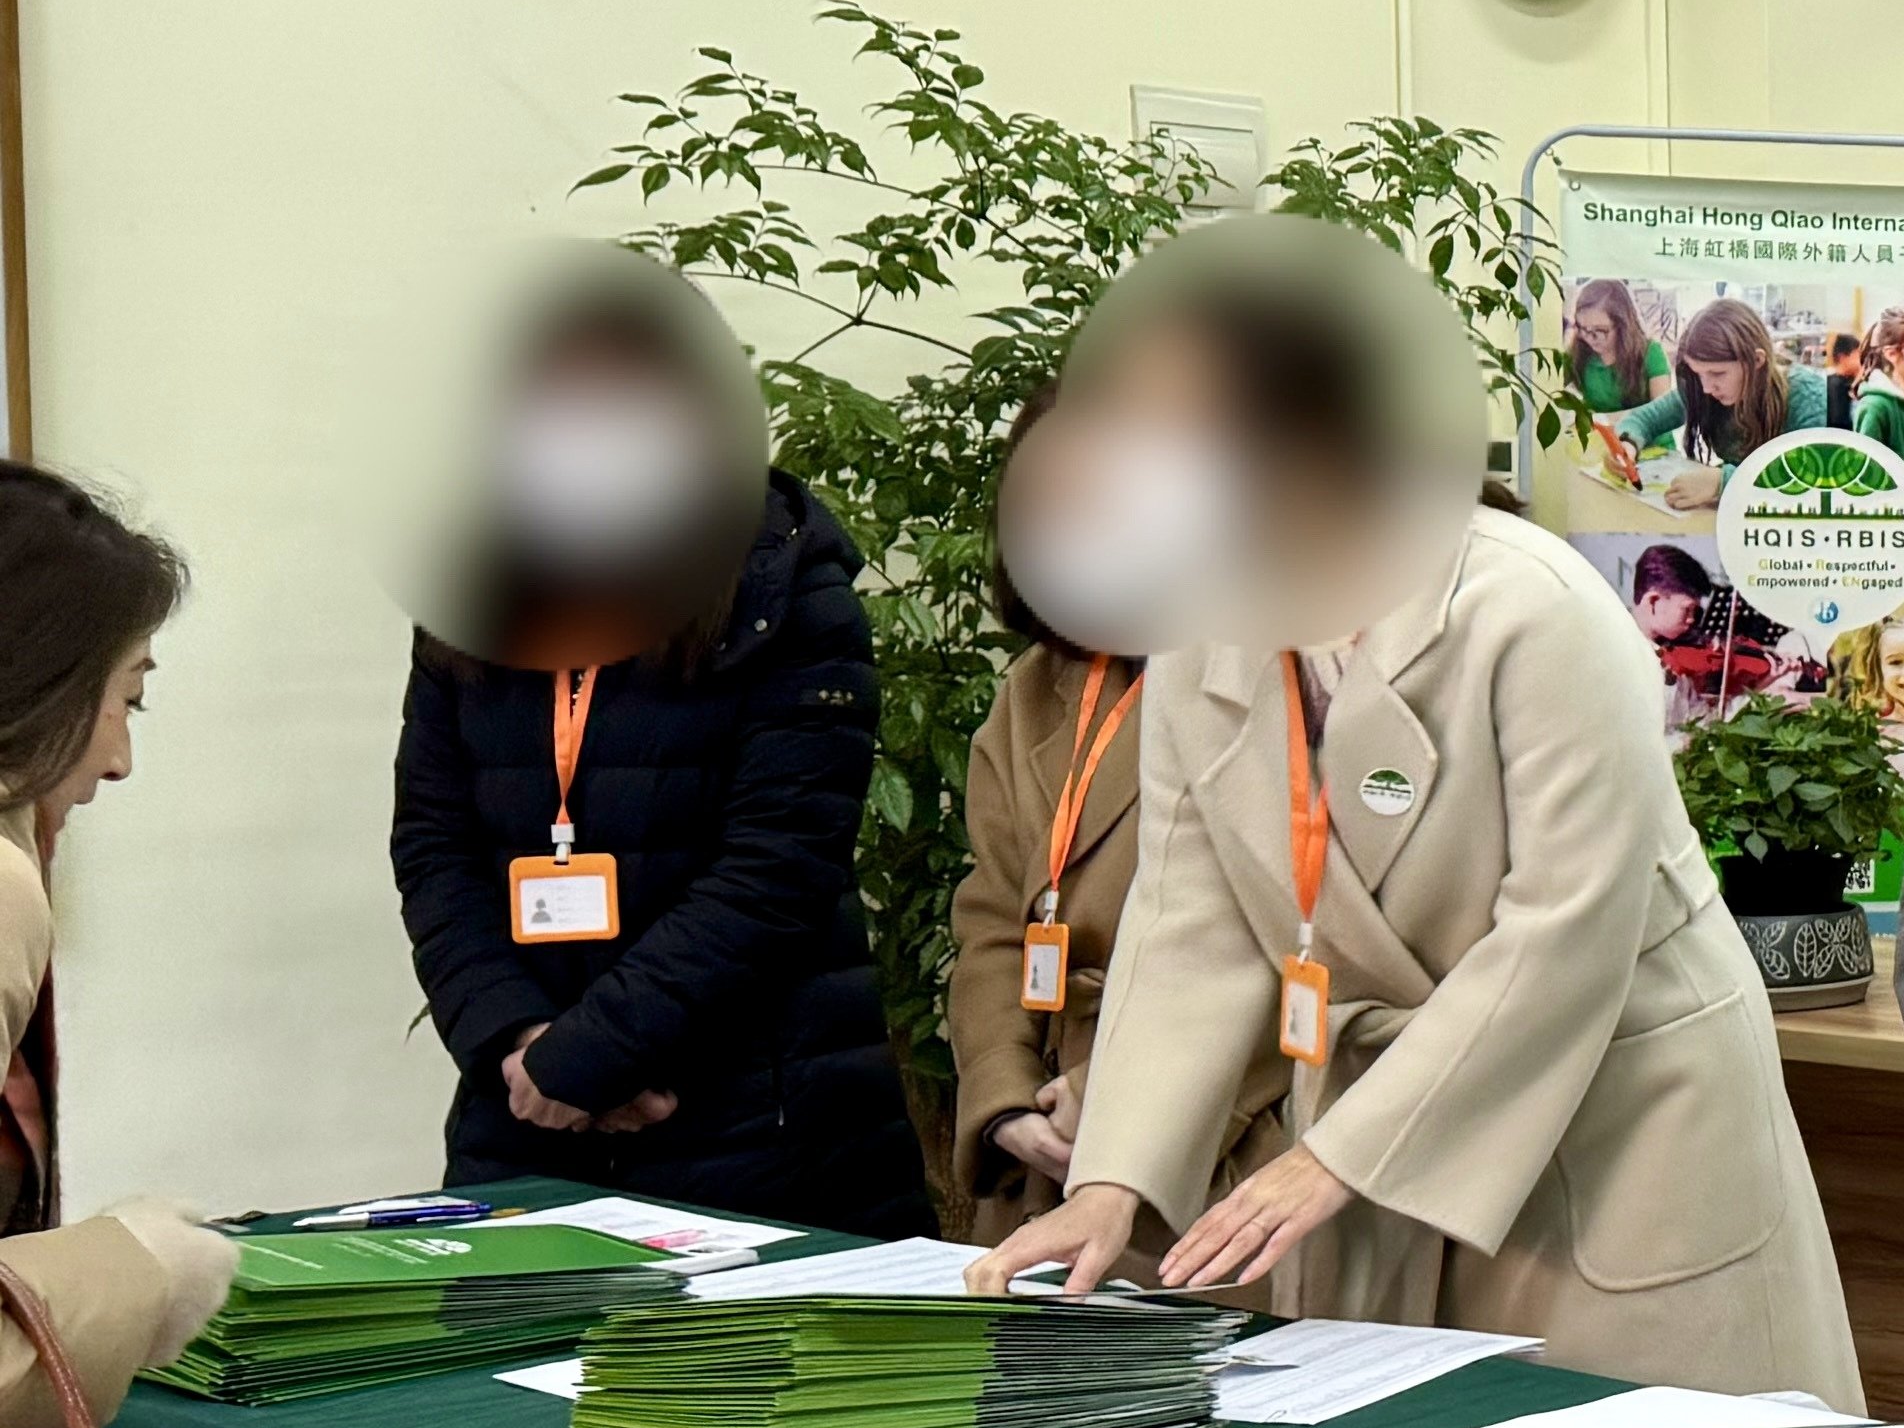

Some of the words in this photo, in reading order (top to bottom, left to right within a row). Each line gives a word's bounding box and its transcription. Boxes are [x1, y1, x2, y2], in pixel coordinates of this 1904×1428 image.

[1583, 202, 1694, 227] Shanghai
[1702, 206, 1763, 231] Hong
[1771, 209, 1825, 231] Qiao
